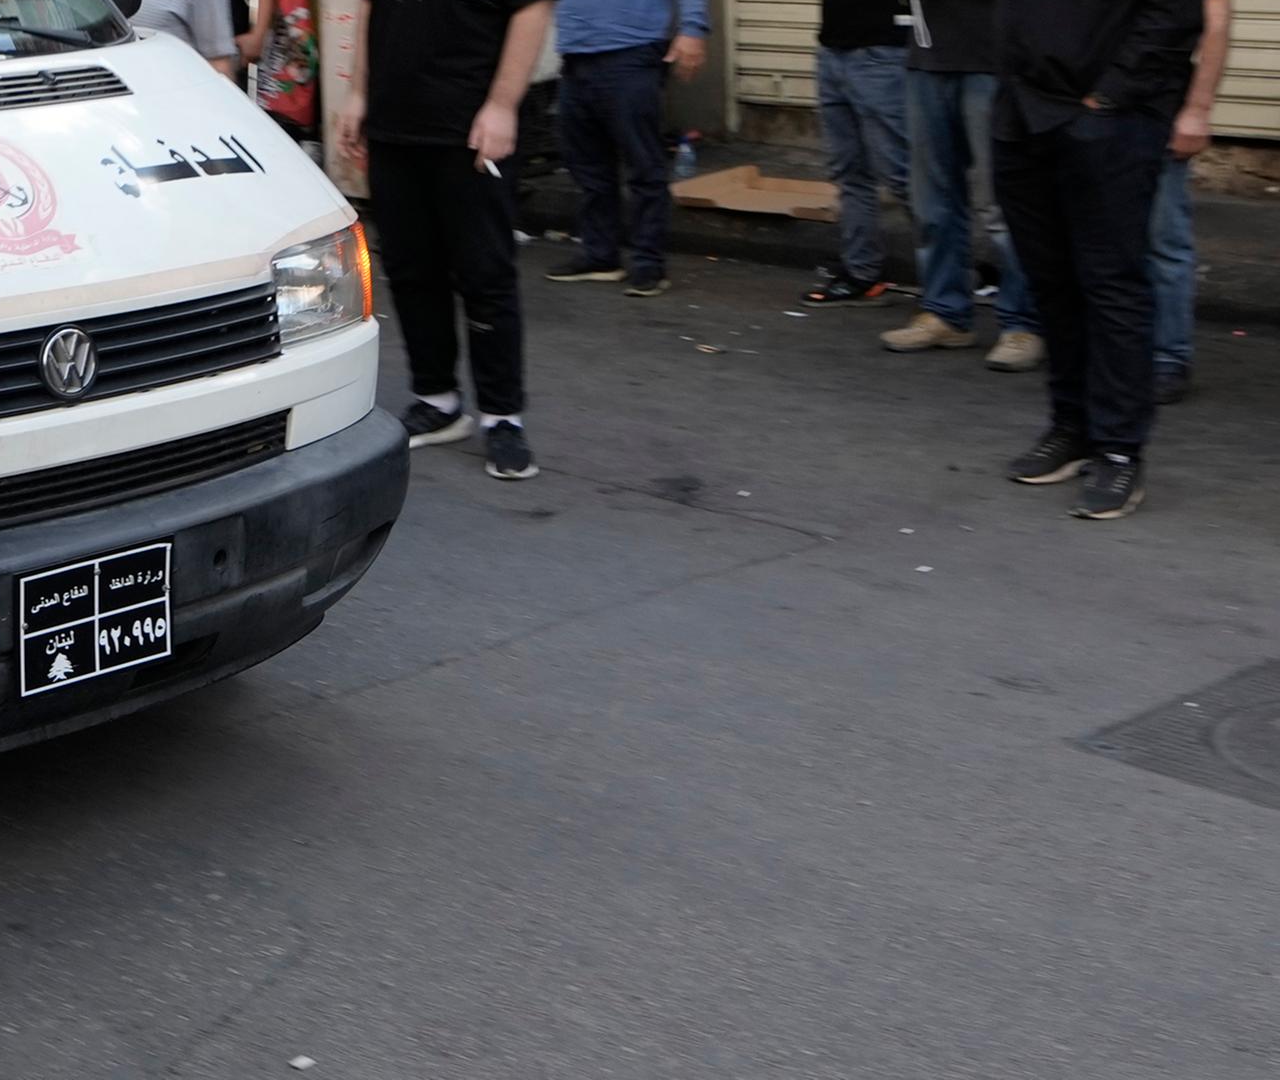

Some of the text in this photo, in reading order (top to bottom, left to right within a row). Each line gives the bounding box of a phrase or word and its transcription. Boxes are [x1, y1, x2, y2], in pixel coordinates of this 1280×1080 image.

[100, 134, 266, 199] الدفاع
[62, 585, 89, 606] الدفاع
[45, 630, 75, 655] لبنان
[99, 617, 167, 655] ٩٢٠٩٩٥
